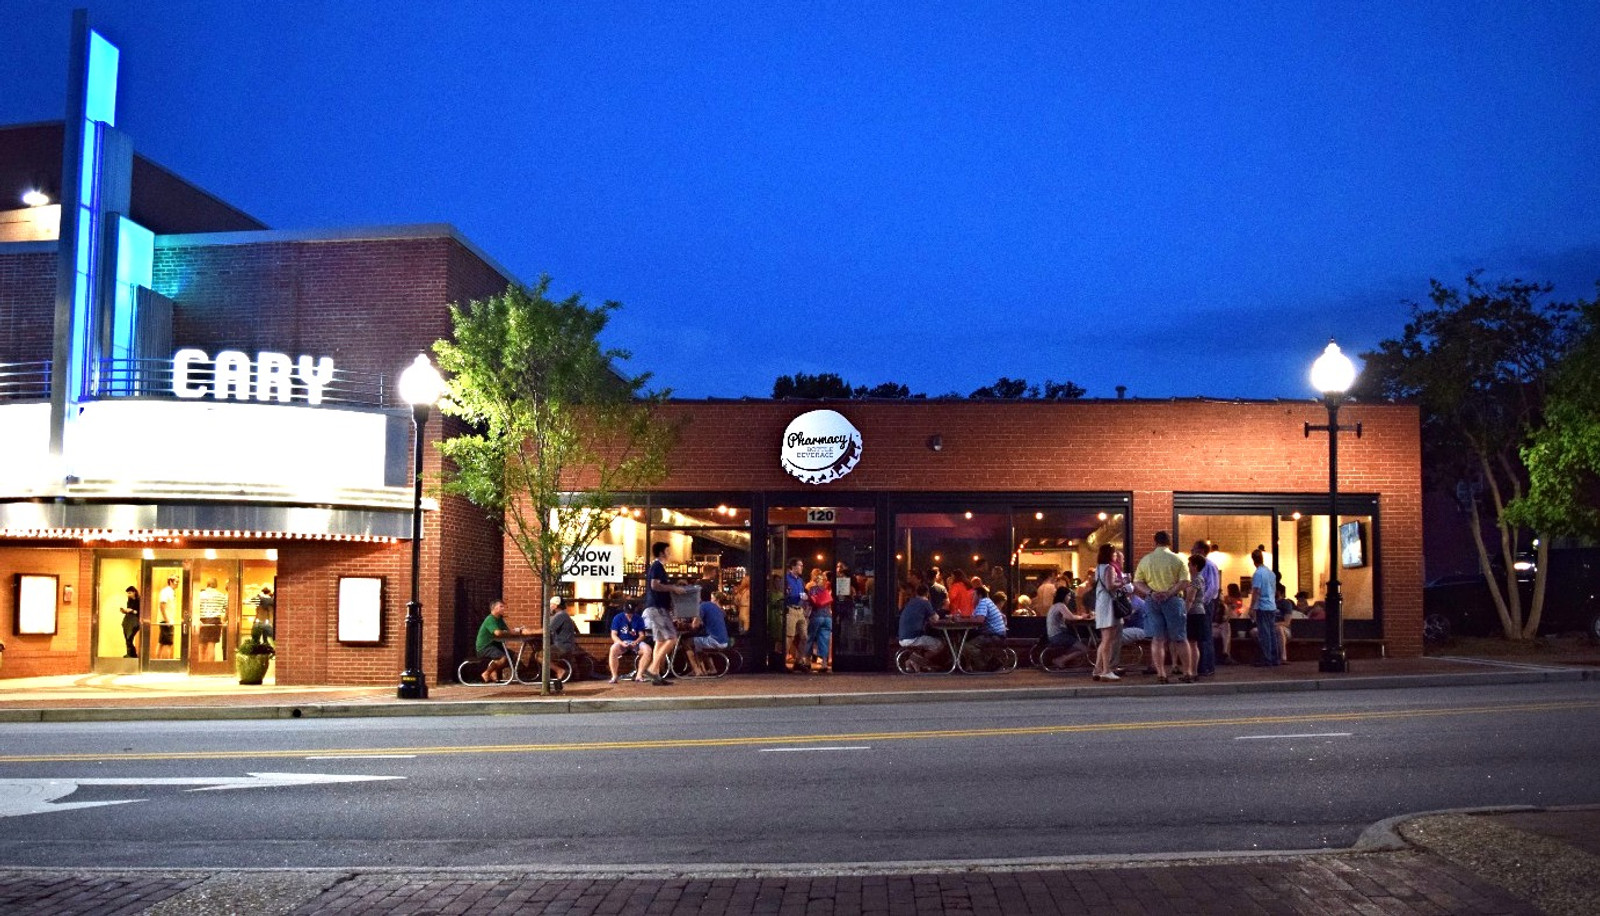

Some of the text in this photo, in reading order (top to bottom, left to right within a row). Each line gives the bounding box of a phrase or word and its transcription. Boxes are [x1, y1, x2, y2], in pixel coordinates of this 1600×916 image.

[172, 348, 334, 405] CARY
[787, 431, 848, 450] Pharmacy
[809, 510, 834, 521] 120
[574, 550, 611, 562] NOW
[570, 564, 615, 577] OPEN!
